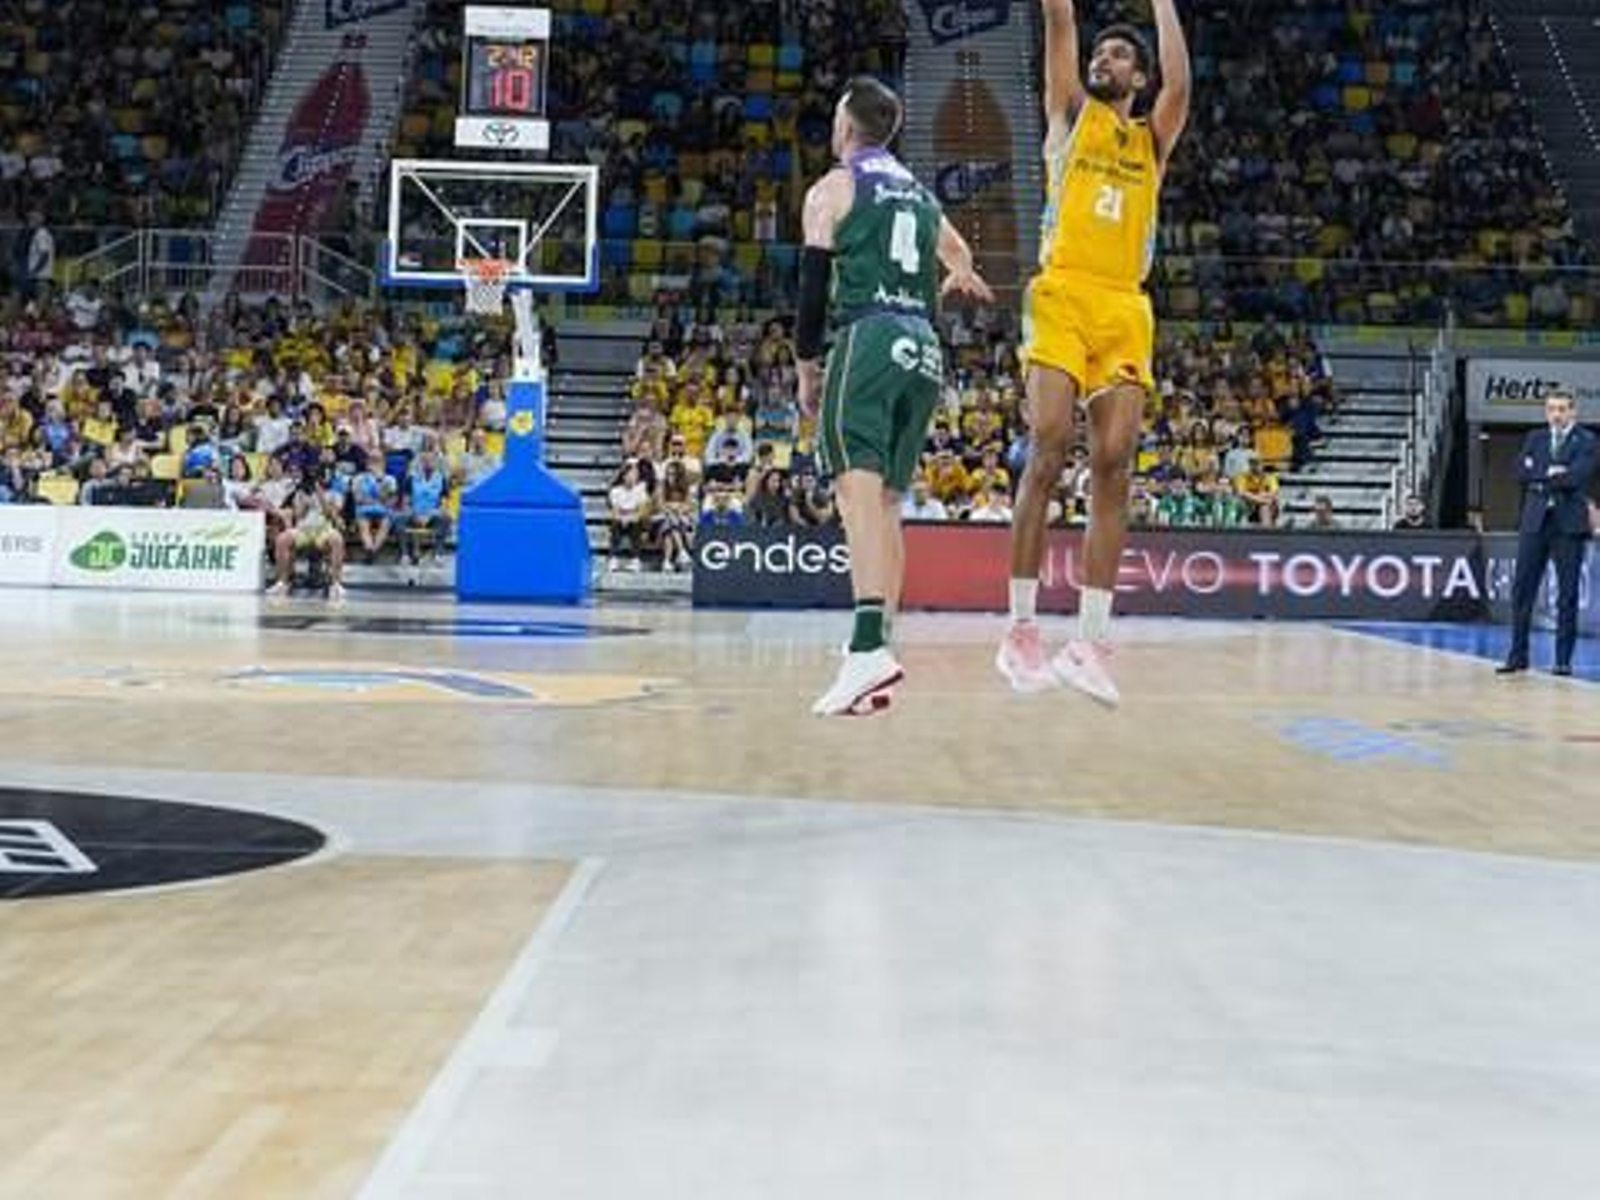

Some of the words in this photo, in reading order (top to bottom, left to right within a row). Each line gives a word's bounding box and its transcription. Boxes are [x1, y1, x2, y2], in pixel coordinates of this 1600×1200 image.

[491, 71, 532, 111] 10
[1094, 185, 1122, 220] 21
[0, 535, 43, 552] ERS
[130, 545, 239, 570] JUCARNE
[700, 535, 851, 573] endes
[1251, 554, 1479, 598] TOYOTA
